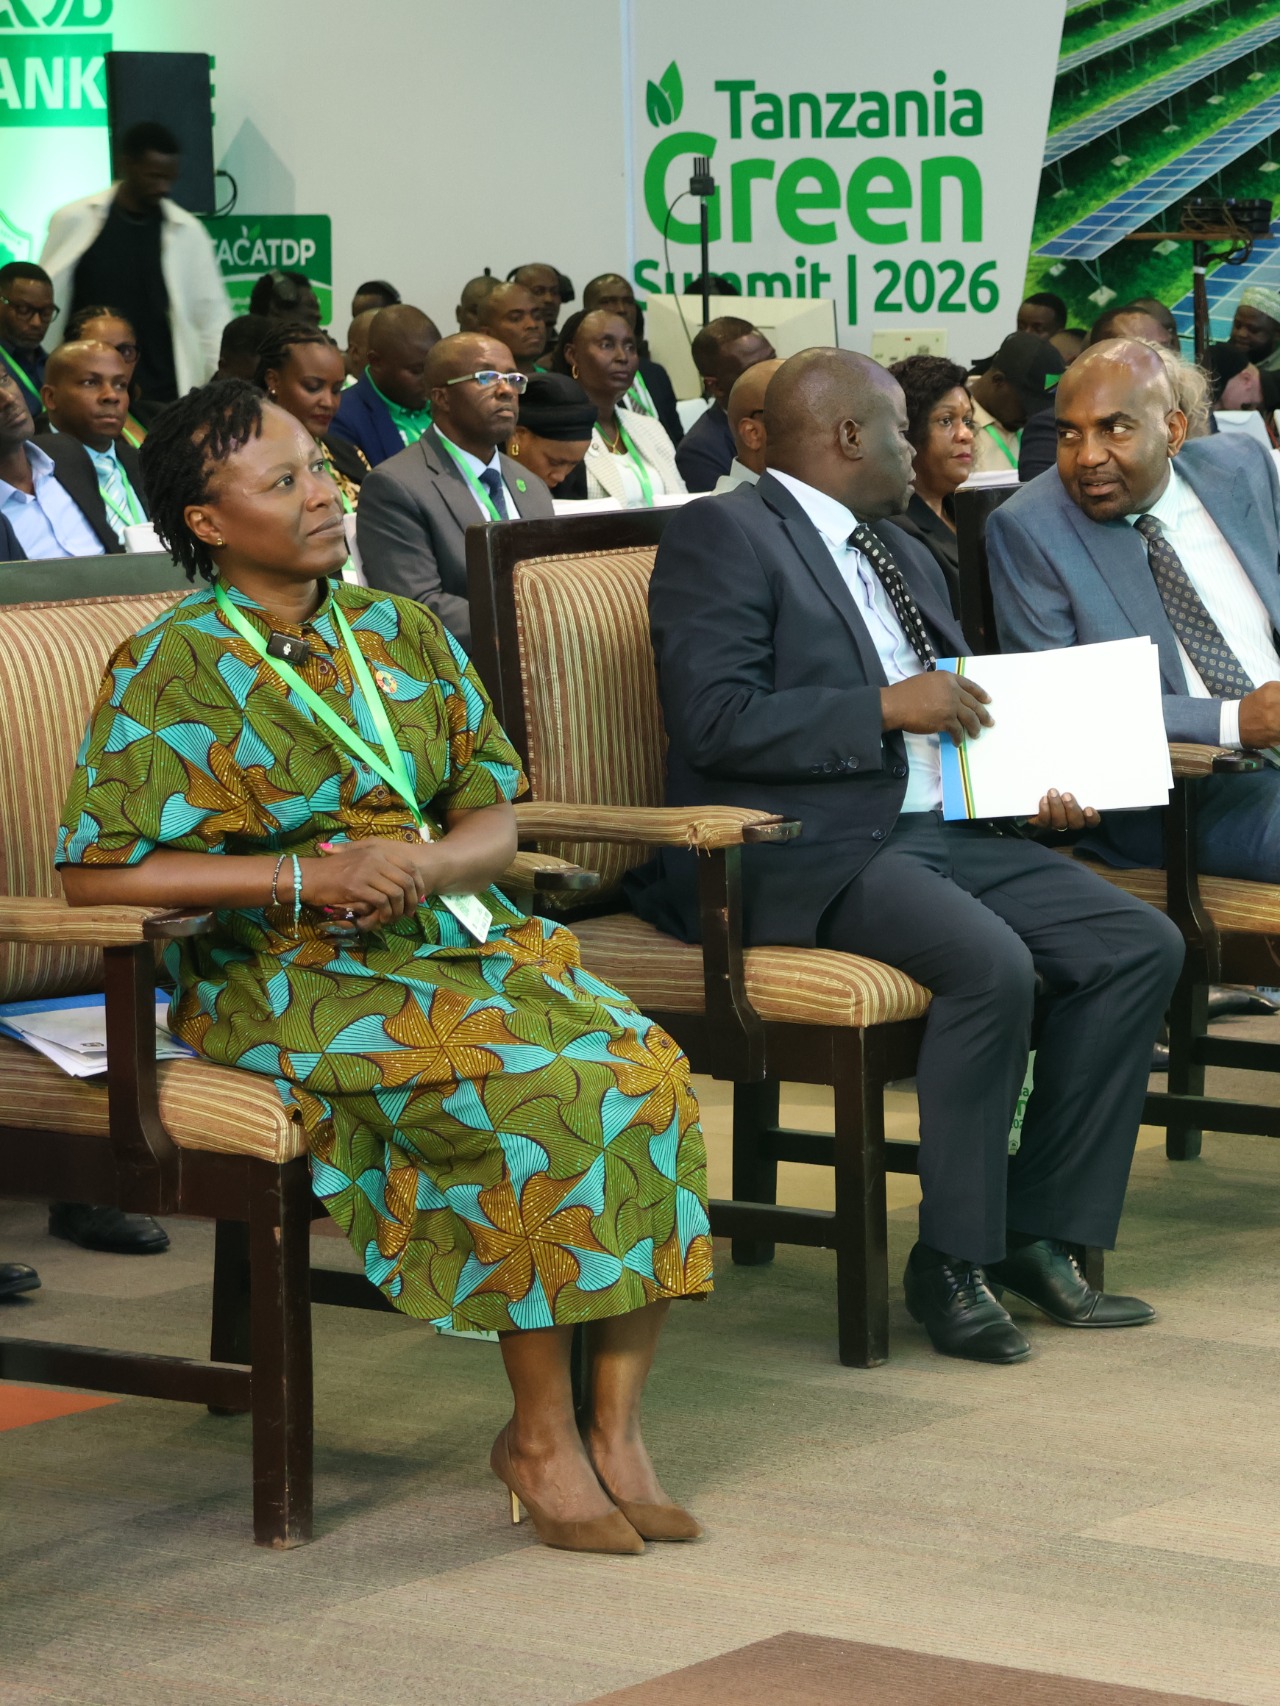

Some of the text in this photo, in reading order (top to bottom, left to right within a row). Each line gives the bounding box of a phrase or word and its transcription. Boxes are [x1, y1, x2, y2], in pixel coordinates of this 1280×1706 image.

[714, 69, 983, 140] Tanzania
[643, 131, 983, 246] Green
[213, 237, 317, 267] ACATDP
[633, 256, 832, 312] Smit
[872, 259, 1001, 314] 2026
